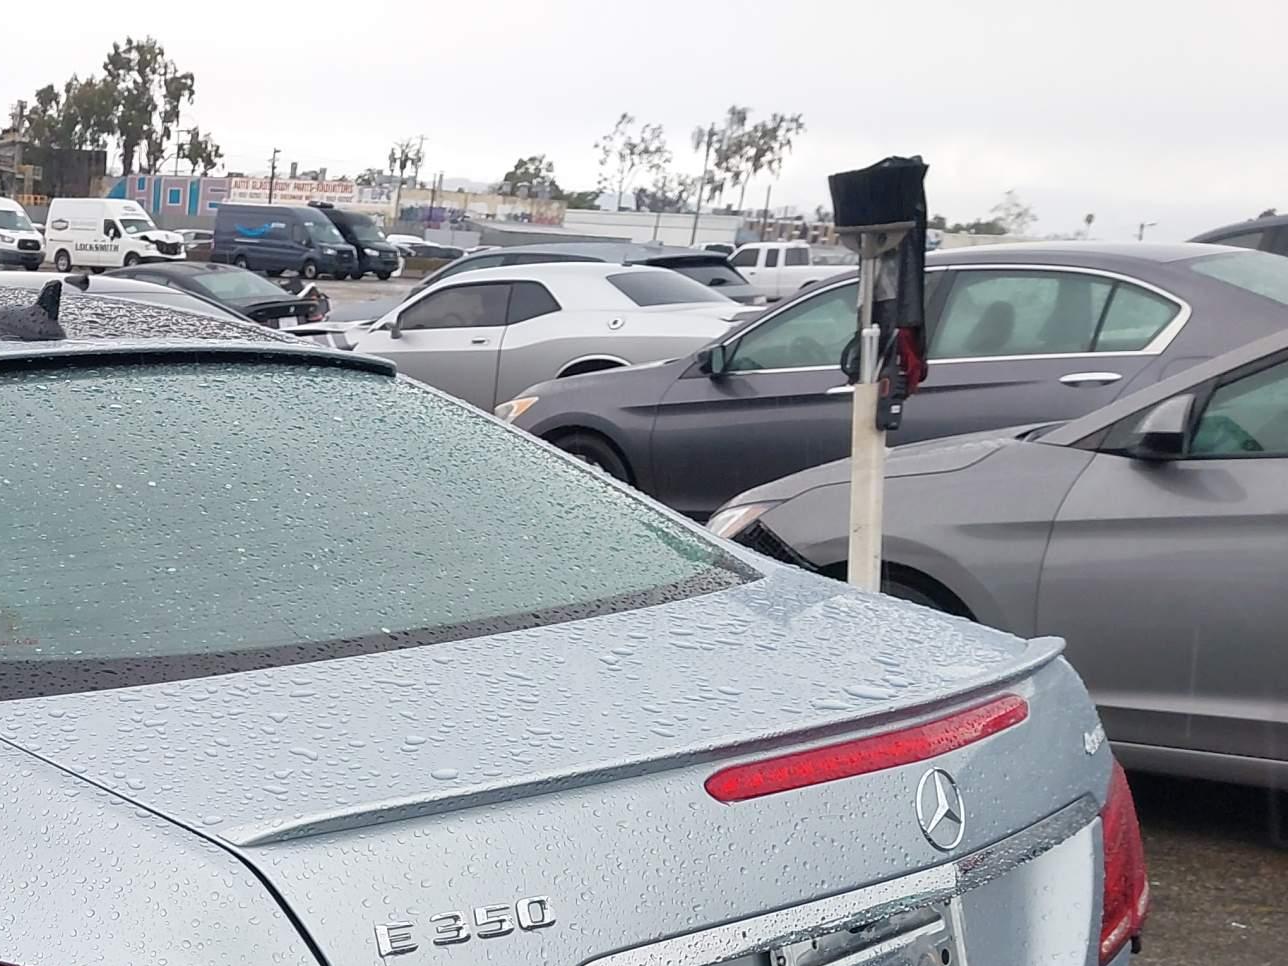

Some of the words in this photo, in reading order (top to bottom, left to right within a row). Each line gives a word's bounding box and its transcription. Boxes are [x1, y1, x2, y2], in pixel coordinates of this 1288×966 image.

[75, 243, 119, 252] LOCKSMITH
[375, 920, 419, 957] E
[430, 895, 556, 946] 350
